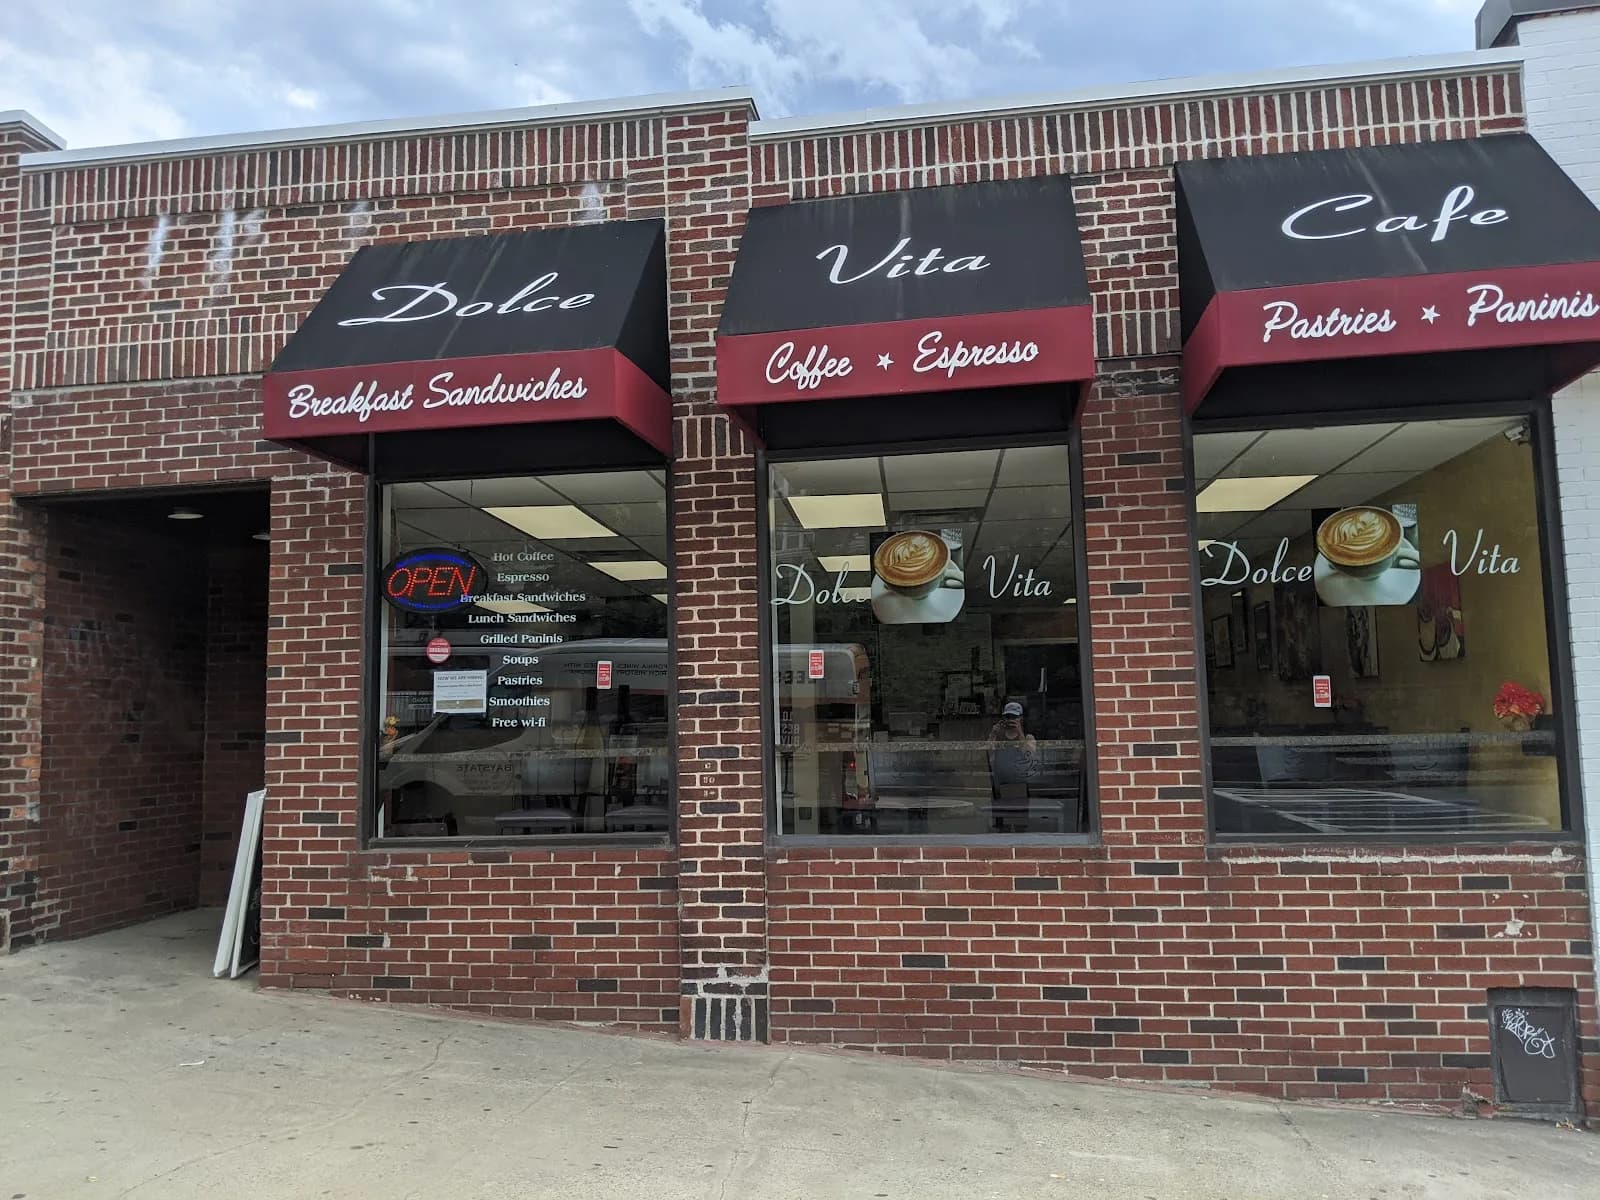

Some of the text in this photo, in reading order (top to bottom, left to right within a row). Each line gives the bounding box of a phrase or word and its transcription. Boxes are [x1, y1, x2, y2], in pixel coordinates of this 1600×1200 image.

[1281, 185, 1509, 242] Cafe
[816, 237, 991, 285] Vita
[337, 272, 596, 327] Dolce
[1262, 284, 1600, 343] Pastries Paninis
[765, 331, 1040, 390] Coffee Espresso
[287, 367, 588, 423] Breakfast Sandwiches
[492, 552, 554, 561] Hot Coffee
[1201, 537, 1312, 586] Dolce
[1443, 529, 1520, 576] Vita
[387, 565, 477, 597] OPEN
[497, 572, 550, 583] Espresso
[982, 554, 1052, 599] Vita
[460, 591, 586, 602] Breakfast Sandwiches
[468, 612, 577, 624] Lunch Sandwiches
[480, 634, 563, 644] Grilled Paninis
[502, 655, 539, 666] Soups
[497, 675, 543, 686] Pastries
[488, 696, 551, 707] Smoothies
[492, 717, 546, 728] Free wi-fi
